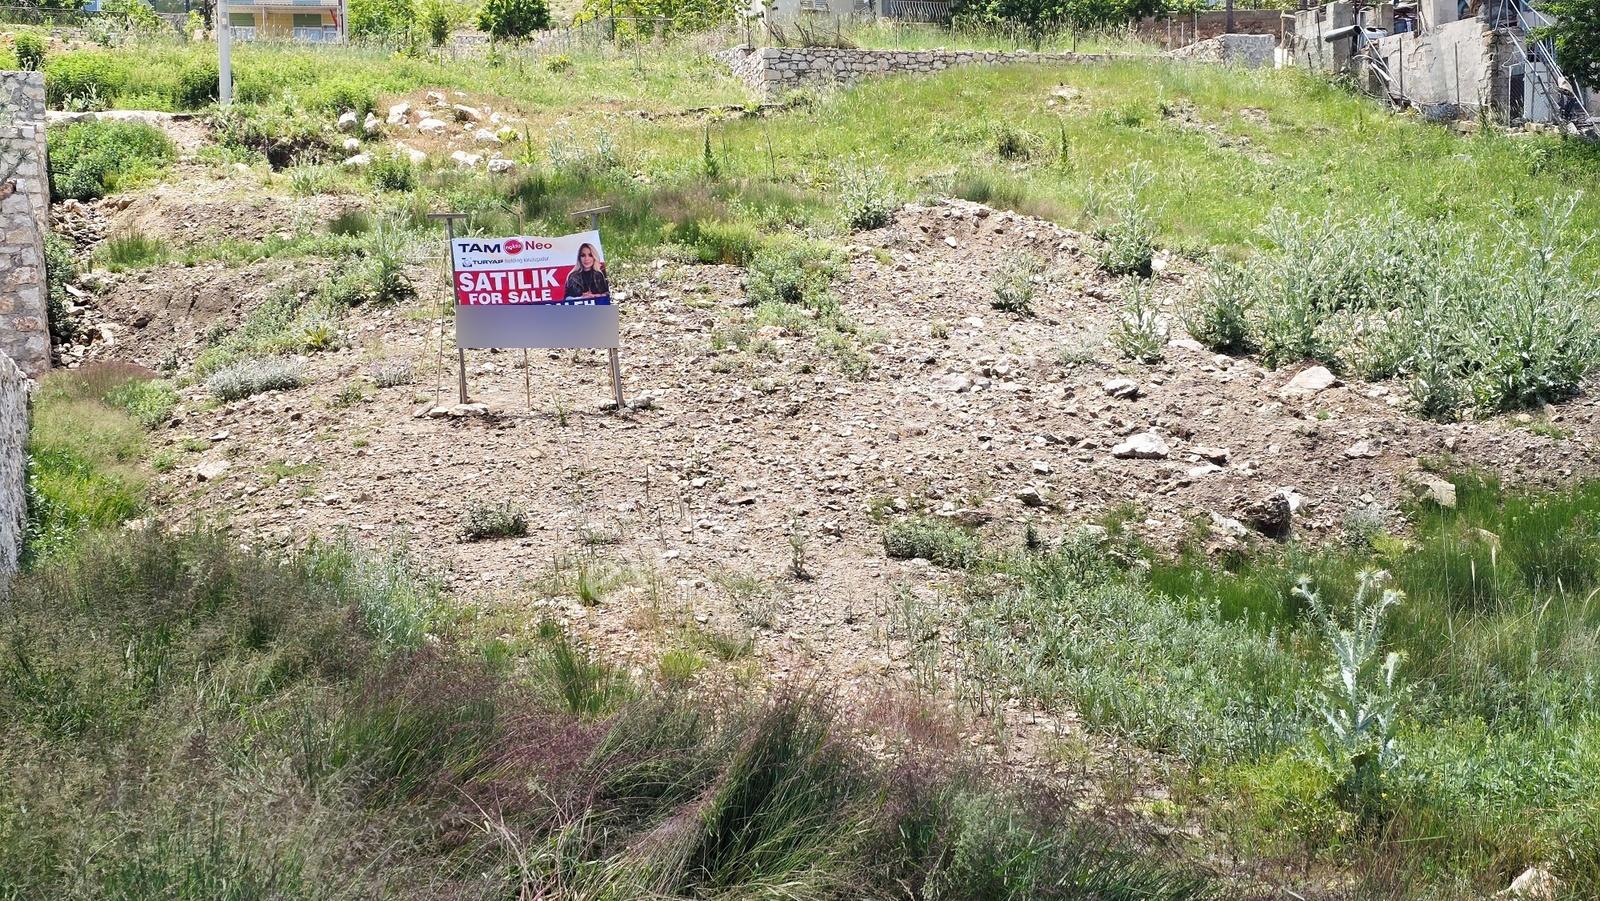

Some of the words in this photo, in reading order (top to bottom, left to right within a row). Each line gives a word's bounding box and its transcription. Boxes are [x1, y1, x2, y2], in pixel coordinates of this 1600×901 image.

[458, 243, 501, 253] TAM
[525, 241, 552, 250] Neo
[459, 268, 560, 292] SATILIK
[468, 293, 503, 305] FOR
[508, 289, 552, 304] SALE
